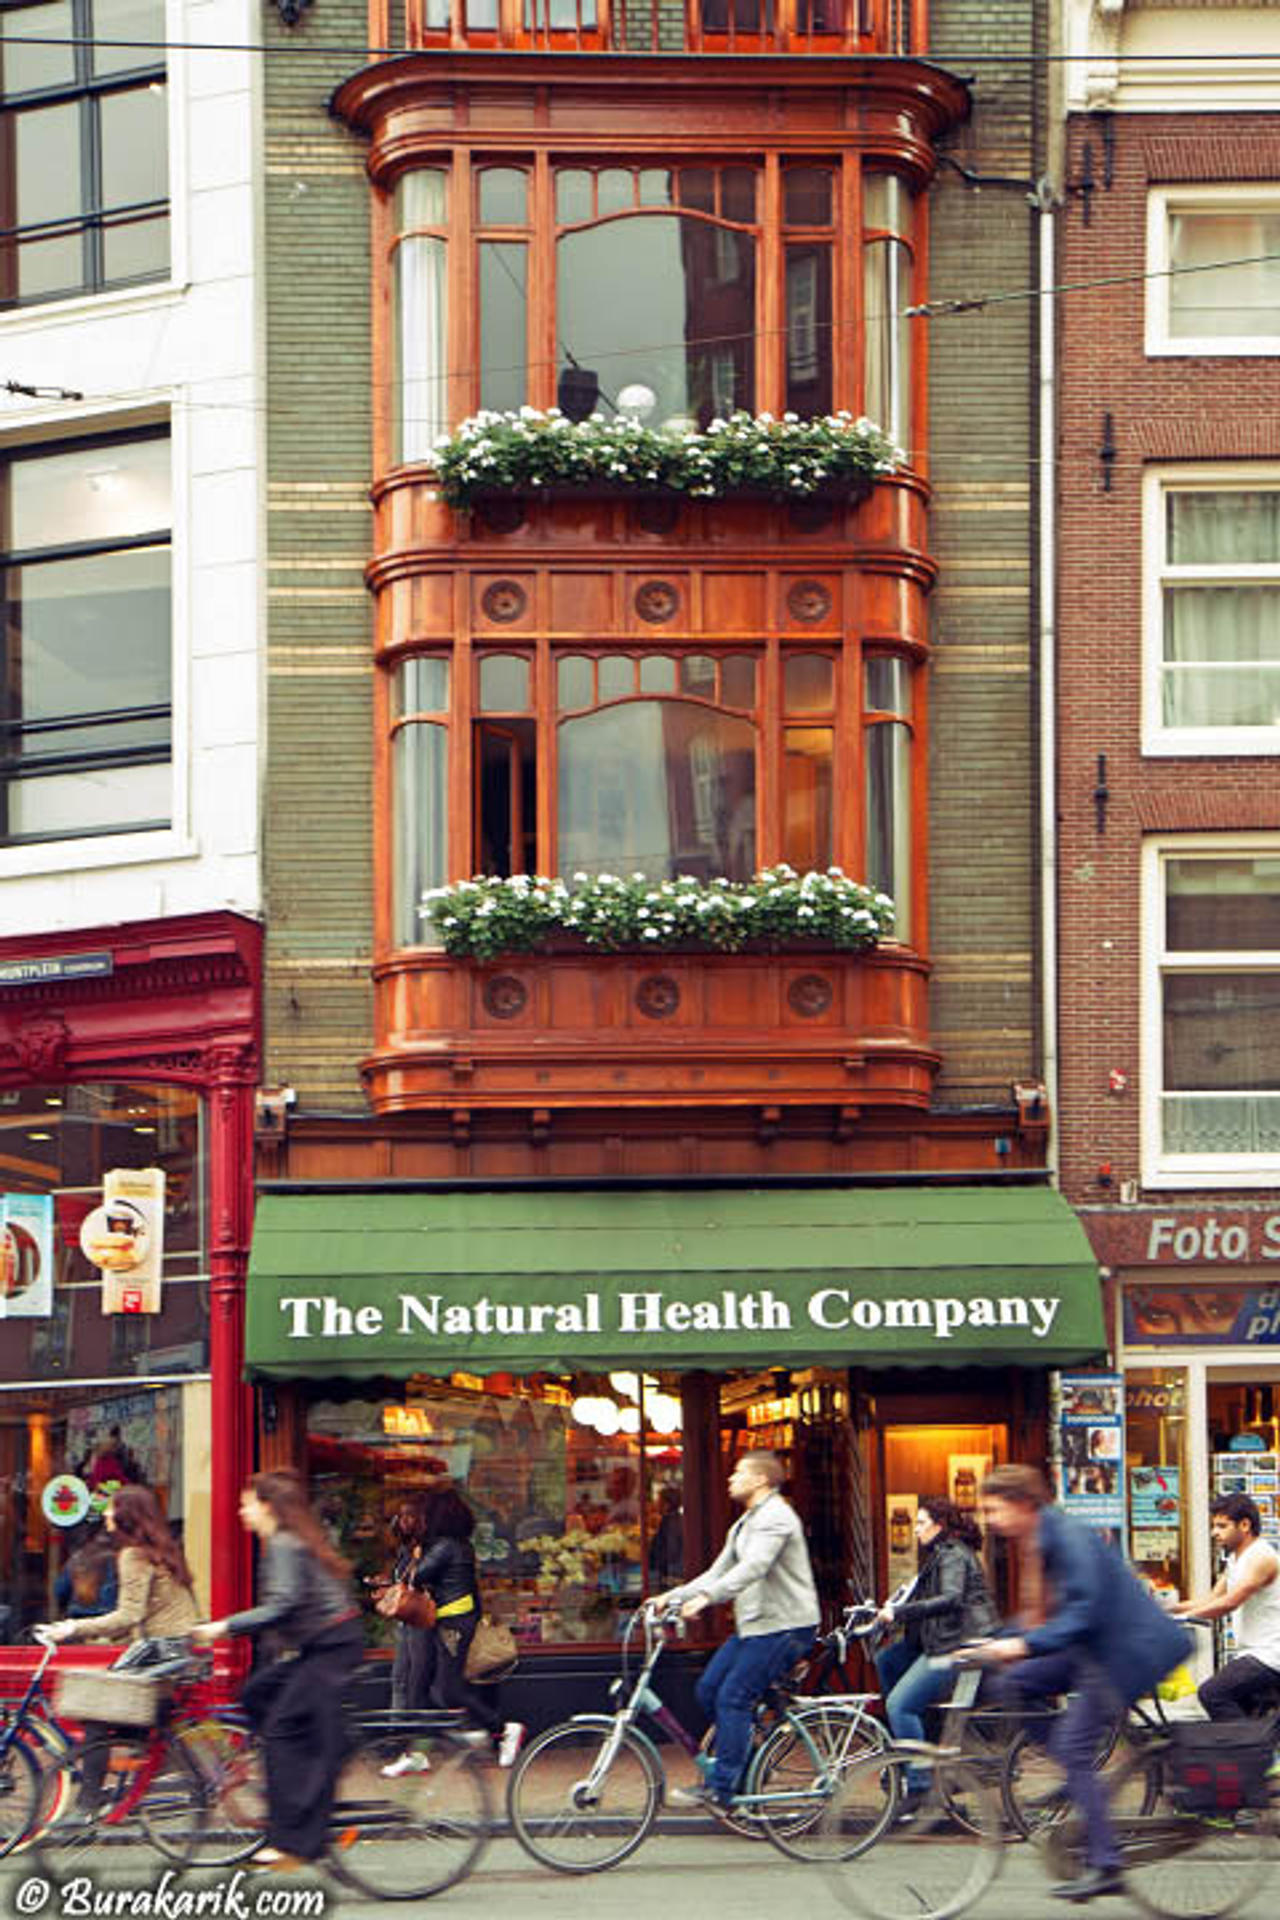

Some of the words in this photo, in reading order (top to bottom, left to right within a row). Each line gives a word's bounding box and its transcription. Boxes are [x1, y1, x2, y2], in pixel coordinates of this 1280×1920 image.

[1148, 1219, 1248, 1259] Foto
[281, 1298, 382, 1336] The
[399, 1294, 601, 1334] Natural
[619, 1291, 791, 1331] Health
[809, 1289, 1059, 1337] Company
